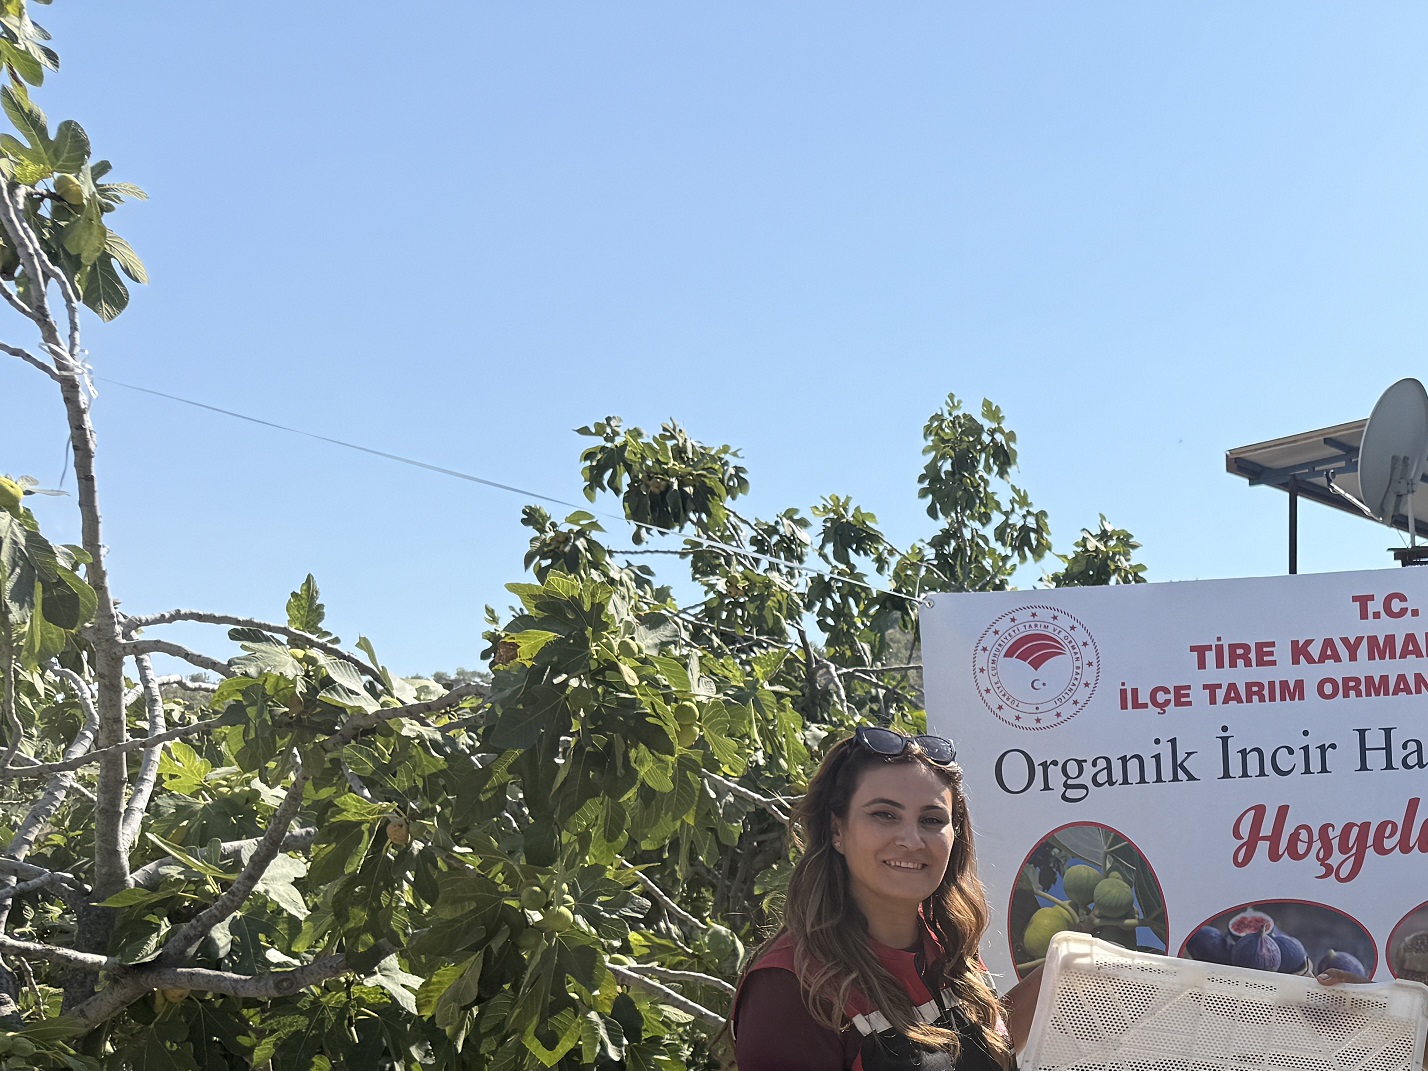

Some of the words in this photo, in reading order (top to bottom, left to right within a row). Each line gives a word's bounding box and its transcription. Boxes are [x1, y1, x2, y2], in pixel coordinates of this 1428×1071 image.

[1352, 592, 1419, 620] T.C.
[1190, 636, 1277, 670] TİRE
[1119, 682, 1192, 715] İLÇE
[1203, 679, 1305, 705] TARIM
[994, 737, 1201, 804] Organik
[1215, 725, 1338, 780] İncir
